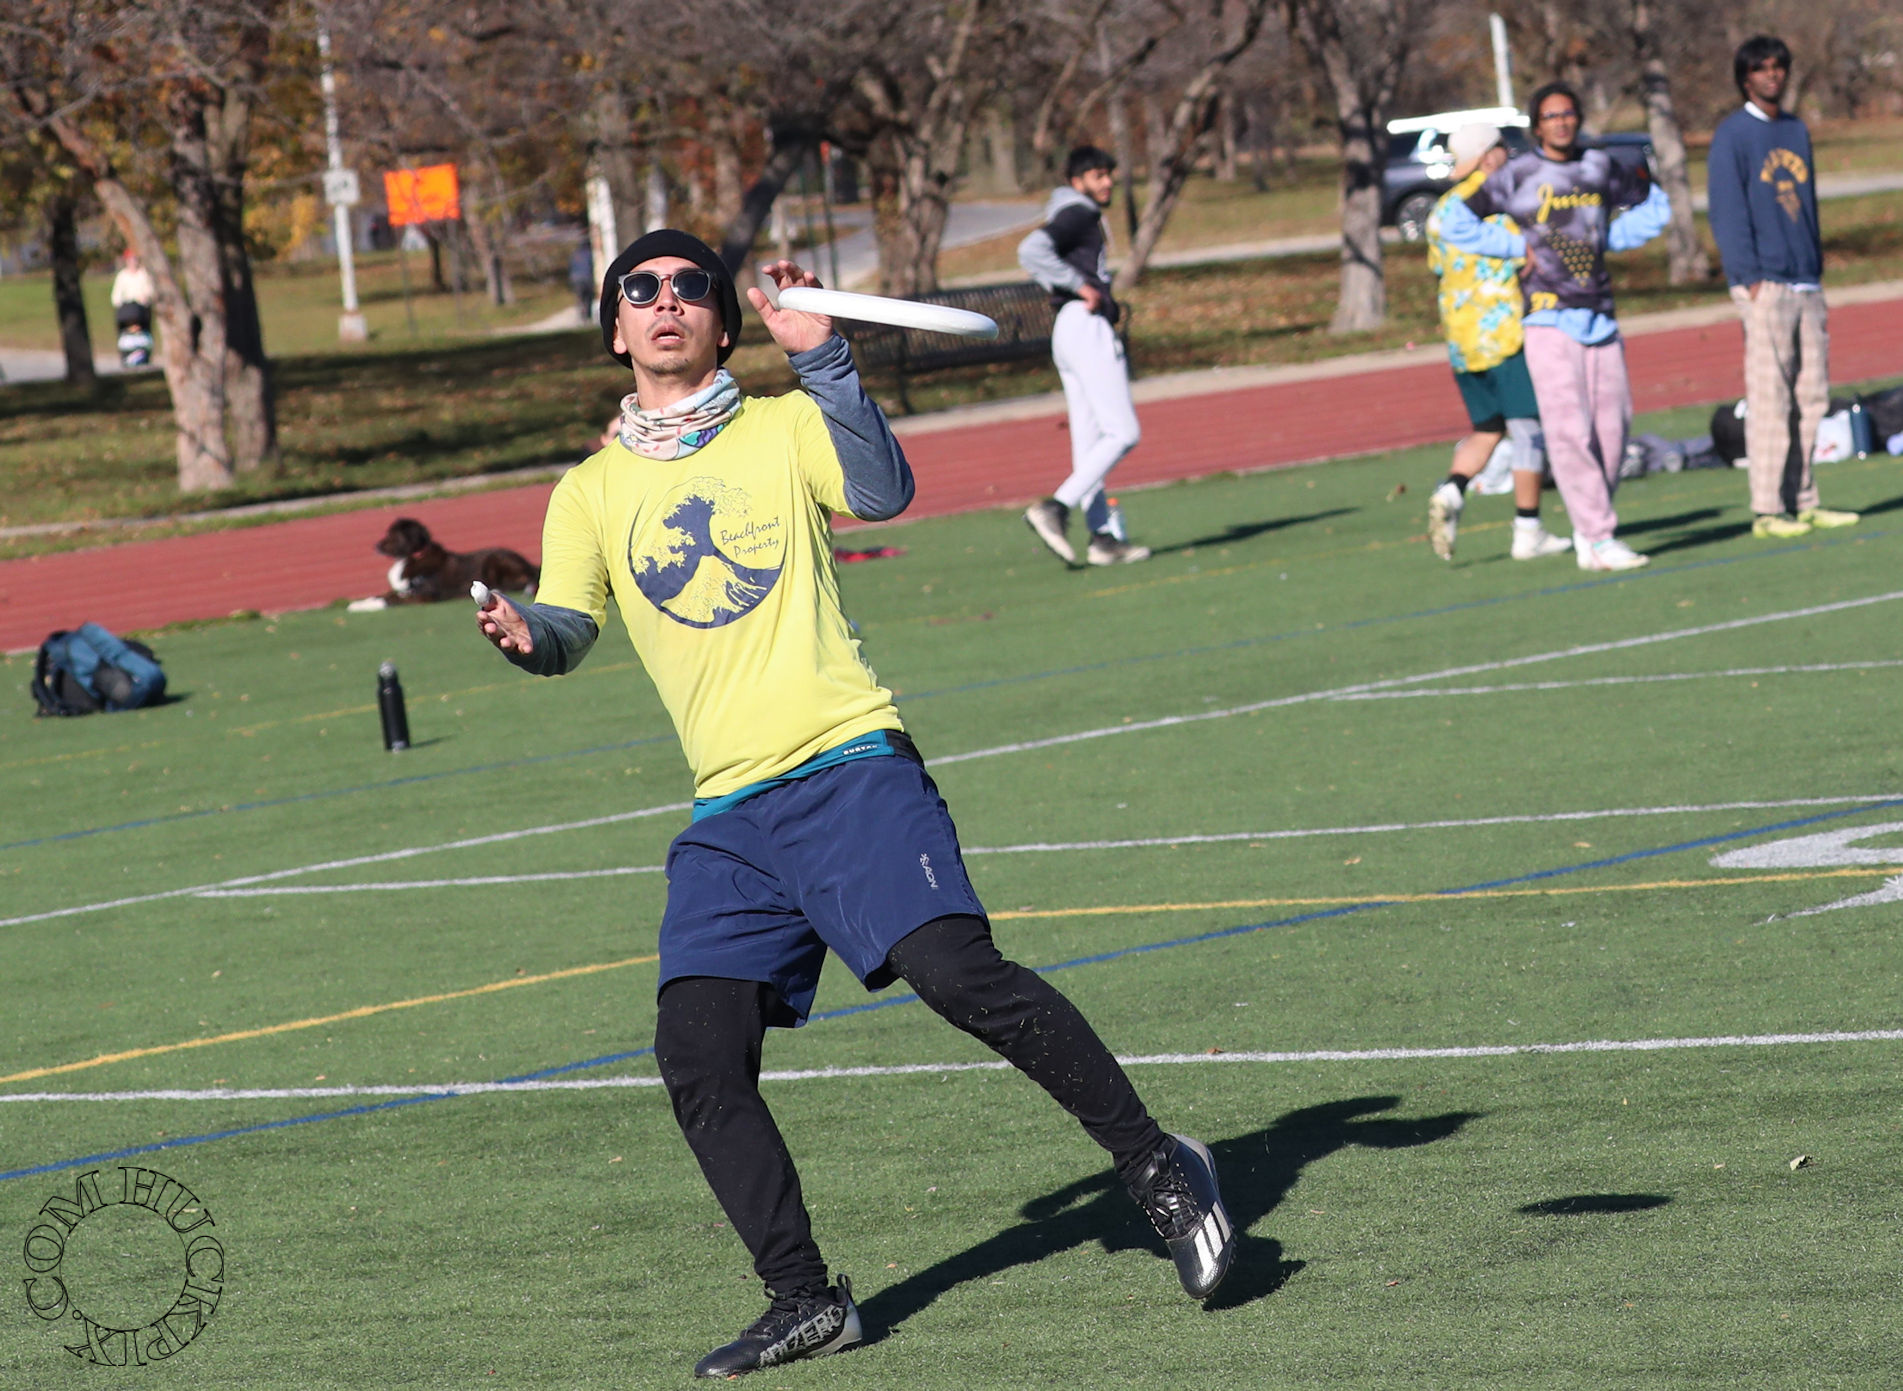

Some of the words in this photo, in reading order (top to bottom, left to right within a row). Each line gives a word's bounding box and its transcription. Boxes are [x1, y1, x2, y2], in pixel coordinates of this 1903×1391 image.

[1536, 183, 1602, 224] Juice
[720, 514, 780, 545] Beachfront
[733, 537, 779, 558] Property
